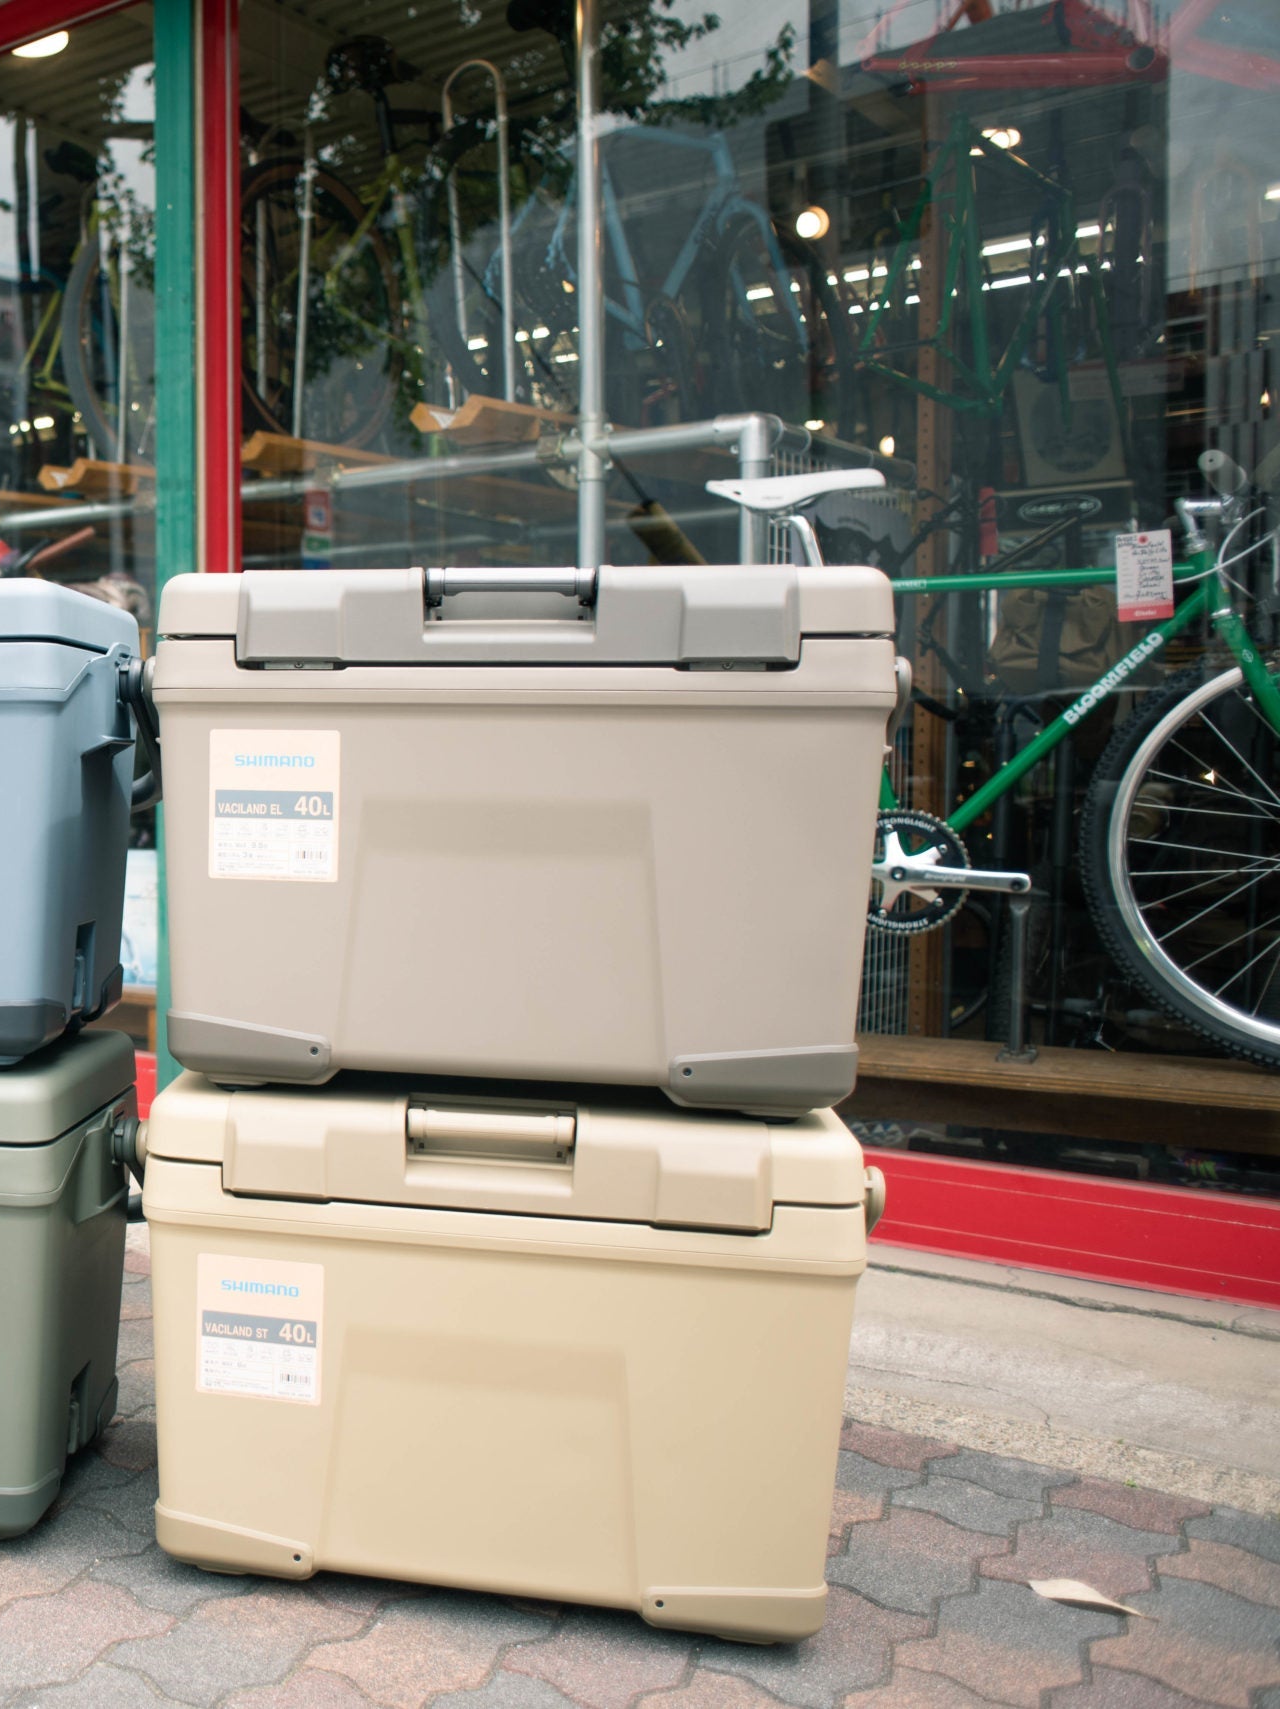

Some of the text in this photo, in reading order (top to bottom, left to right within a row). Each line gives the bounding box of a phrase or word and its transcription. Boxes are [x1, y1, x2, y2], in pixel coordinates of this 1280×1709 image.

[1062, 632, 1164, 725] BLOOMFIELD
[234, 754, 315, 768] SHIMANO
[218, 802, 267, 815] VACILAND
[270, 803, 283, 815] EL
[221, 1279, 300, 1297] SHIMANO
[204, 1322, 253, 1337] VACILAND
[255, 1327, 269, 1339] ST
